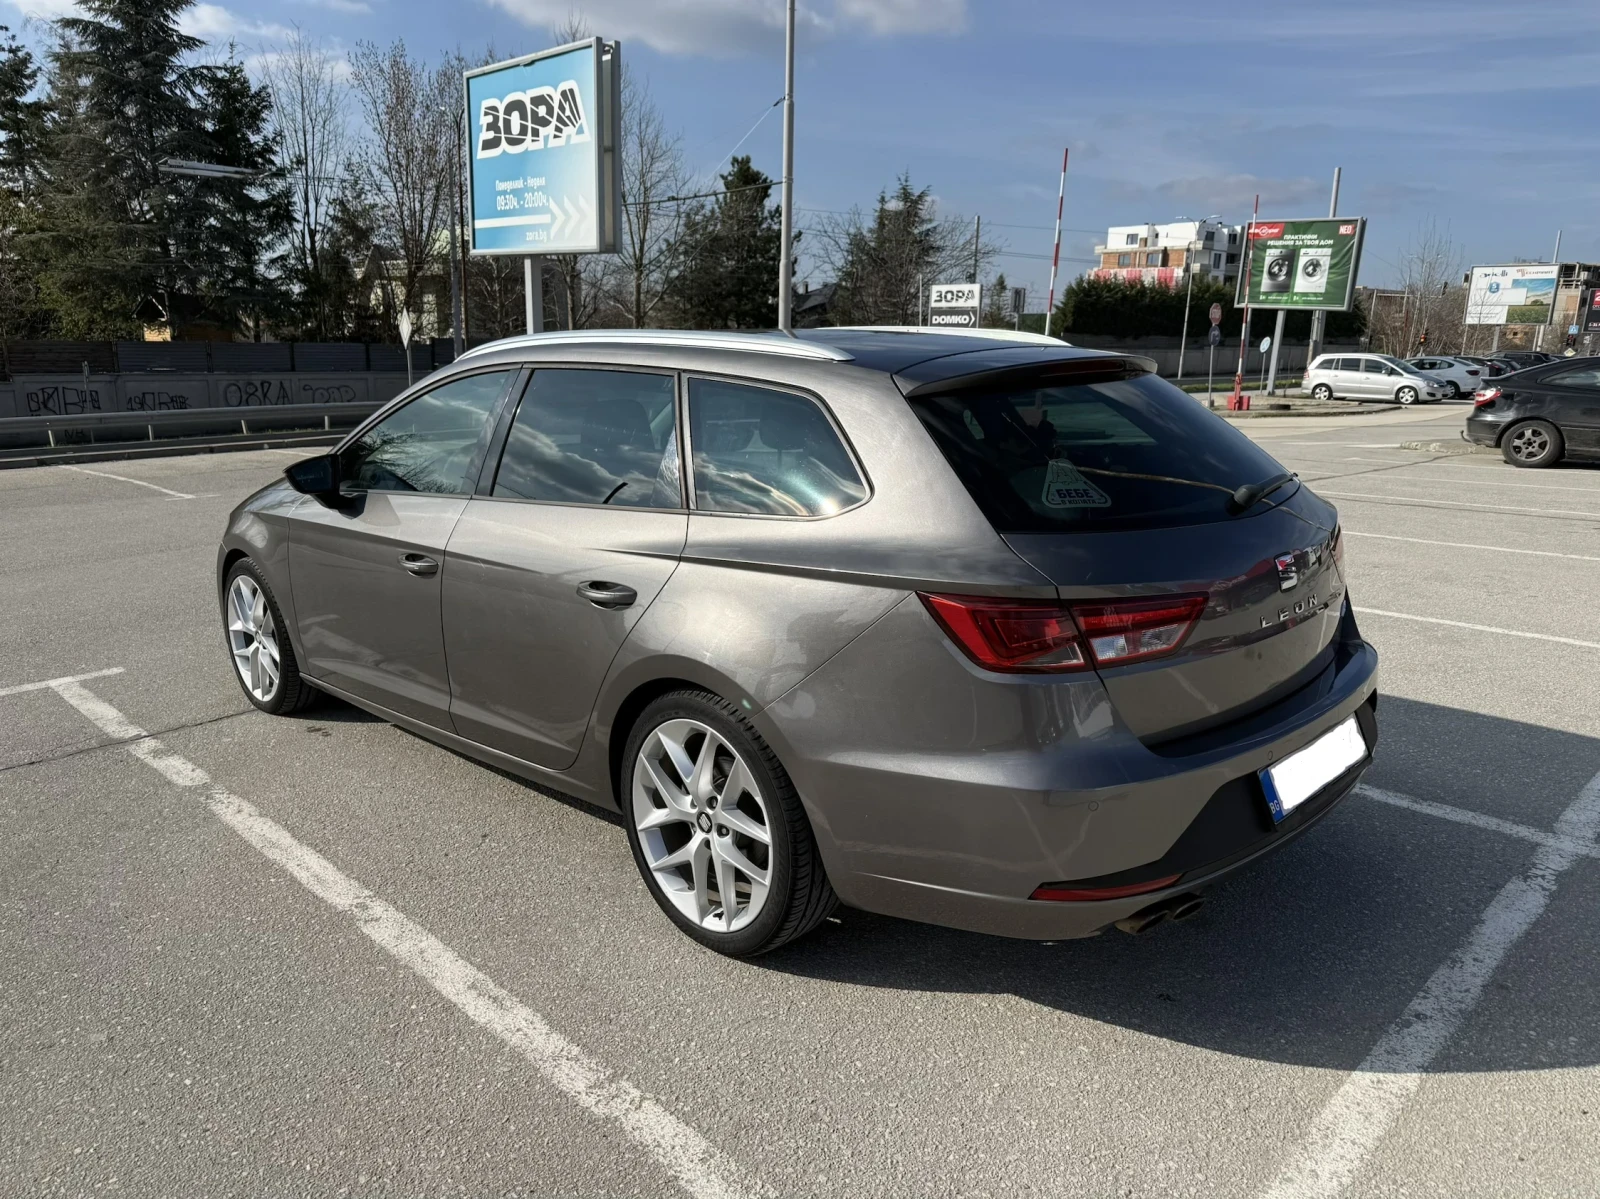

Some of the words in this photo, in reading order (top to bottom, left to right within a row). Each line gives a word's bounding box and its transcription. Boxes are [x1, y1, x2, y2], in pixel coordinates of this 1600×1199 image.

[479, 84, 587, 155] ЗОРА
[496, 178, 524, 192] Понеделник
[527, 176, 546, 189] Неделя
[496, 195, 519, 211] 09:30ч.
[524, 190, 549, 208] 20:00ч.
[526, 229, 547, 243] zora.bg
[1339, 225, 1351, 235] NEO
[934, 290, 975, 303] ЗОРА
[932, 315, 970, 324] DOMKO
[1056, 489, 1093, 498] БЕБЕ
[1260, 593, 1318, 629] LEON
[1269, 800, 1280, 814] BG
